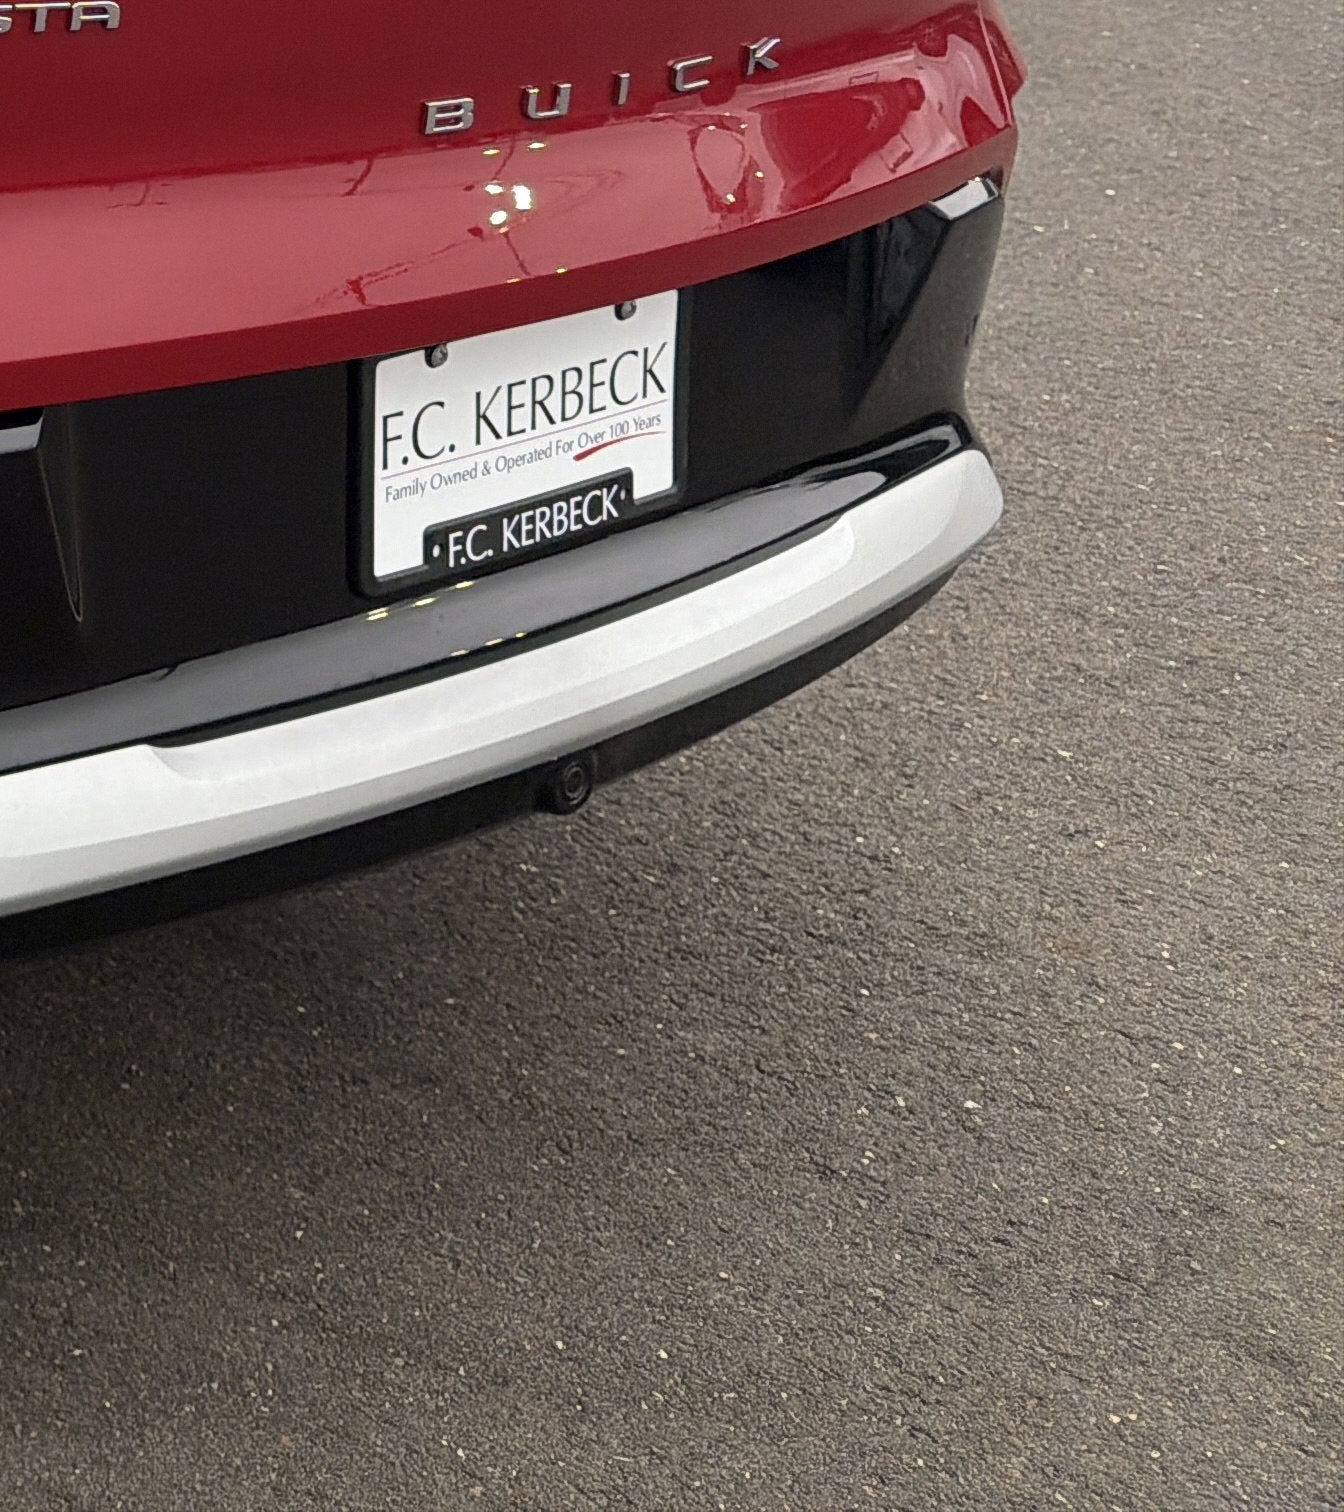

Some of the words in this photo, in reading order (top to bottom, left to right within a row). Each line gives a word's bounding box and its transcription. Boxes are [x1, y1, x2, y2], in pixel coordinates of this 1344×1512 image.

[424, 37, 781, 135] BUICK
[381, 400, 456, 471] F.C.
[474, 341, 669, 446] KERBECK
[385, 477, 427, 503] Family
[430, 461, 478, 491] Owned
[481, 459, 492, 477] &
[494, 441, 552, 474] Operated
[555, 439, 574, 456] For
[577, 430, 606, 449] Over
[609, 420, 630, 439] 100
[633, 414, 662, 432] Years
[448, 524, 494, 568] F.C.
[502, 483, 619, 553] KERBECK
